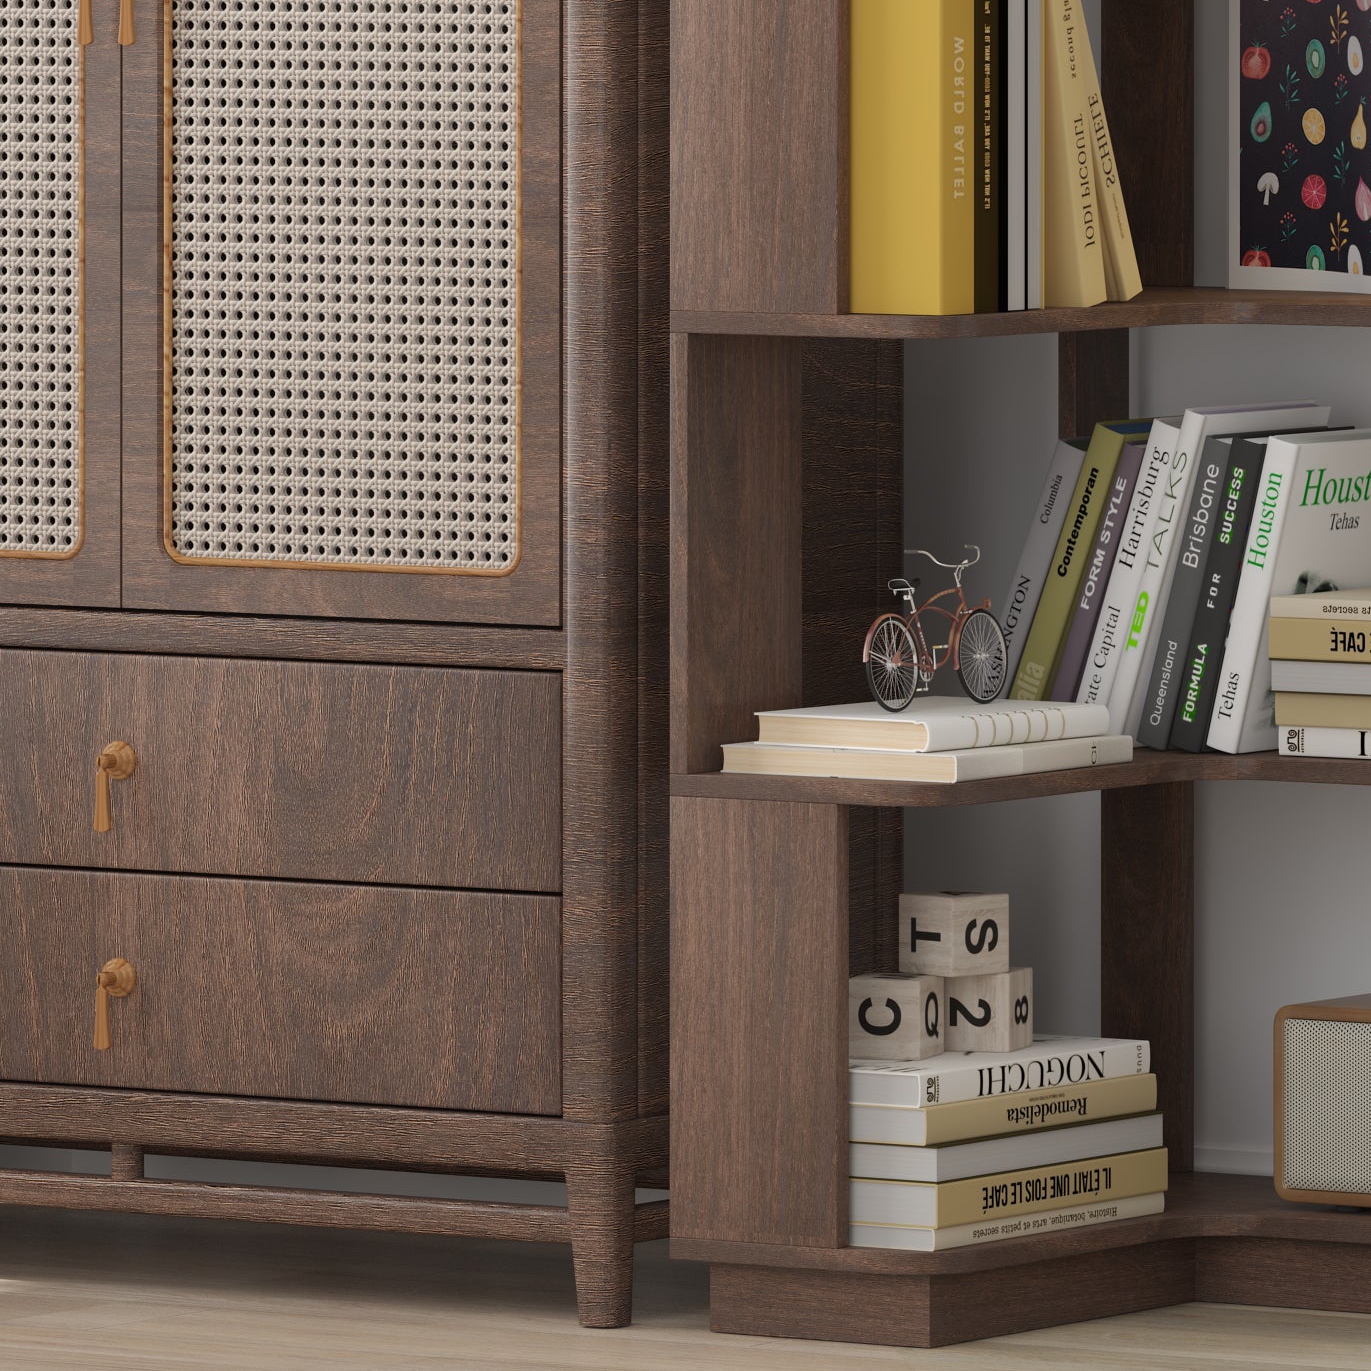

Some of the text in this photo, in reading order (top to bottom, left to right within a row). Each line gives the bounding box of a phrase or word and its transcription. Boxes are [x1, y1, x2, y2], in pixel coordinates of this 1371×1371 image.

[1040, 474, 1063, 524] Columbia
[1057, 467, 1099, 577] Contemporan
[1119, 446, 1169, 569] Harrisburg
[1183, 464, 1219, 568] Brisbane
[1247, 472, 1283, 571] Houston
[1330, 512, 1360, 531] Tehas
[1080, 476, 1127, 610] FORM STYLE
[1126, 451, 1187, 651] TED TALKS
[1182, 467, 1244, 723] FORMULA FOR SUCCESS
[1085, 605, 1121, 705] tate Capital
[1150, 640, 1177, 726] Queensland
[1218, 672, 1240, 720] Tehas
[911, 917, 941, 952] T
[965, 918, 998, 955] S
[858, 997, 901, 1036] C
[925, 991, 939, 1038] Q
[950, 996, 991, 1028] 2
[1014, 995, 1029, 1025] 8
[977, 1051, 1106, 1096] NOGUCHI
[1007, 1097, 1088, 1125] Remodelista
[982, 1167, 1111, 1214] IL ÉTAIT UNE FOIS LE CAFÉ
[972, 1207, 1118, 1238] Histoire, botanique, arts et petits secrets
